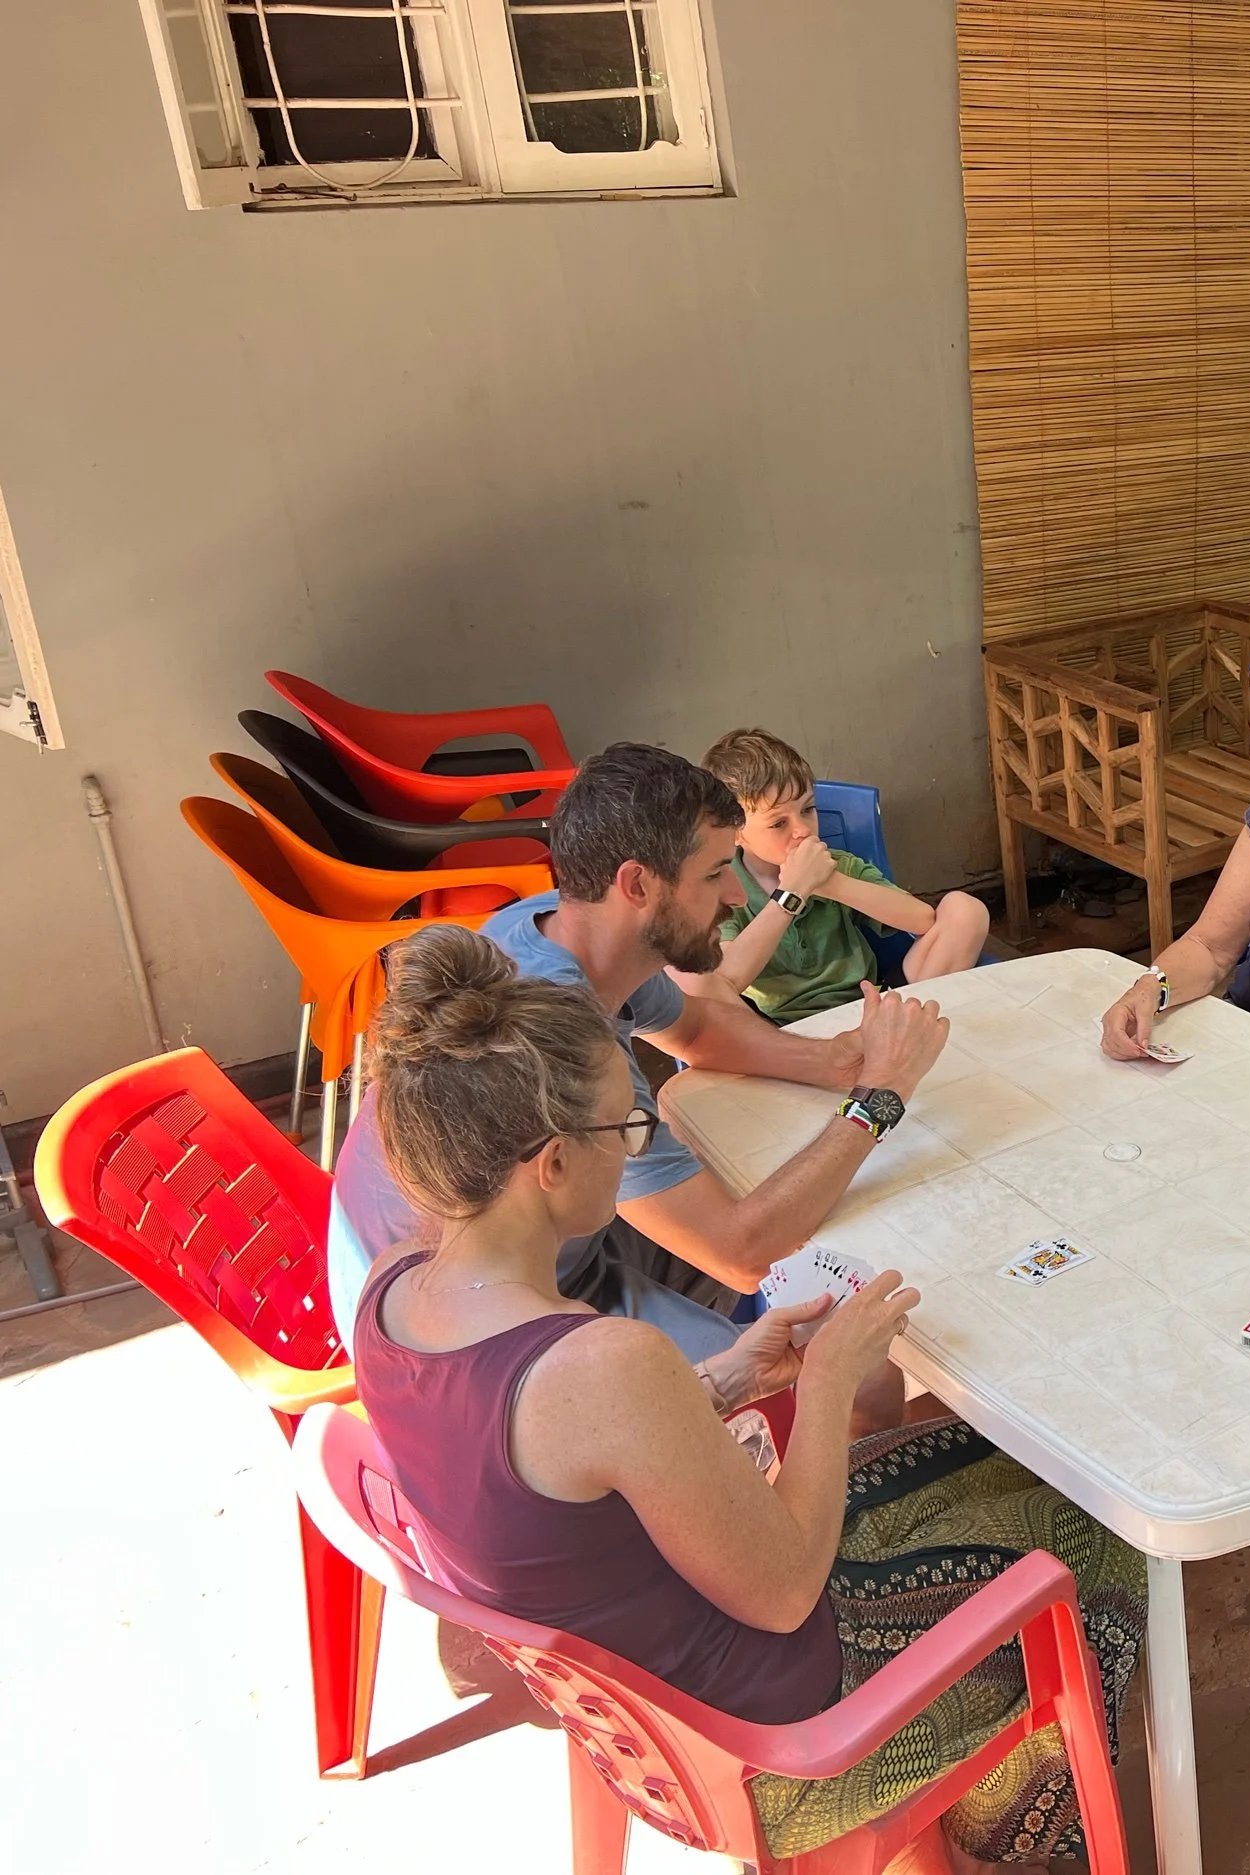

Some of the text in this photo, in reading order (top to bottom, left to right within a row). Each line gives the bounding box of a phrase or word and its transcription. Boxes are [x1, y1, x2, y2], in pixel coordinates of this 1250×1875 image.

[815, 1250, 822, 1260] Q
[824, 1253, 831, 1263] Q
[830, 1255, 838, 1265] 10
[841, 1265, 848, 1274] A
[851, 1270, 859, 1279] Q
[761, 1283, 769, 1291] A
